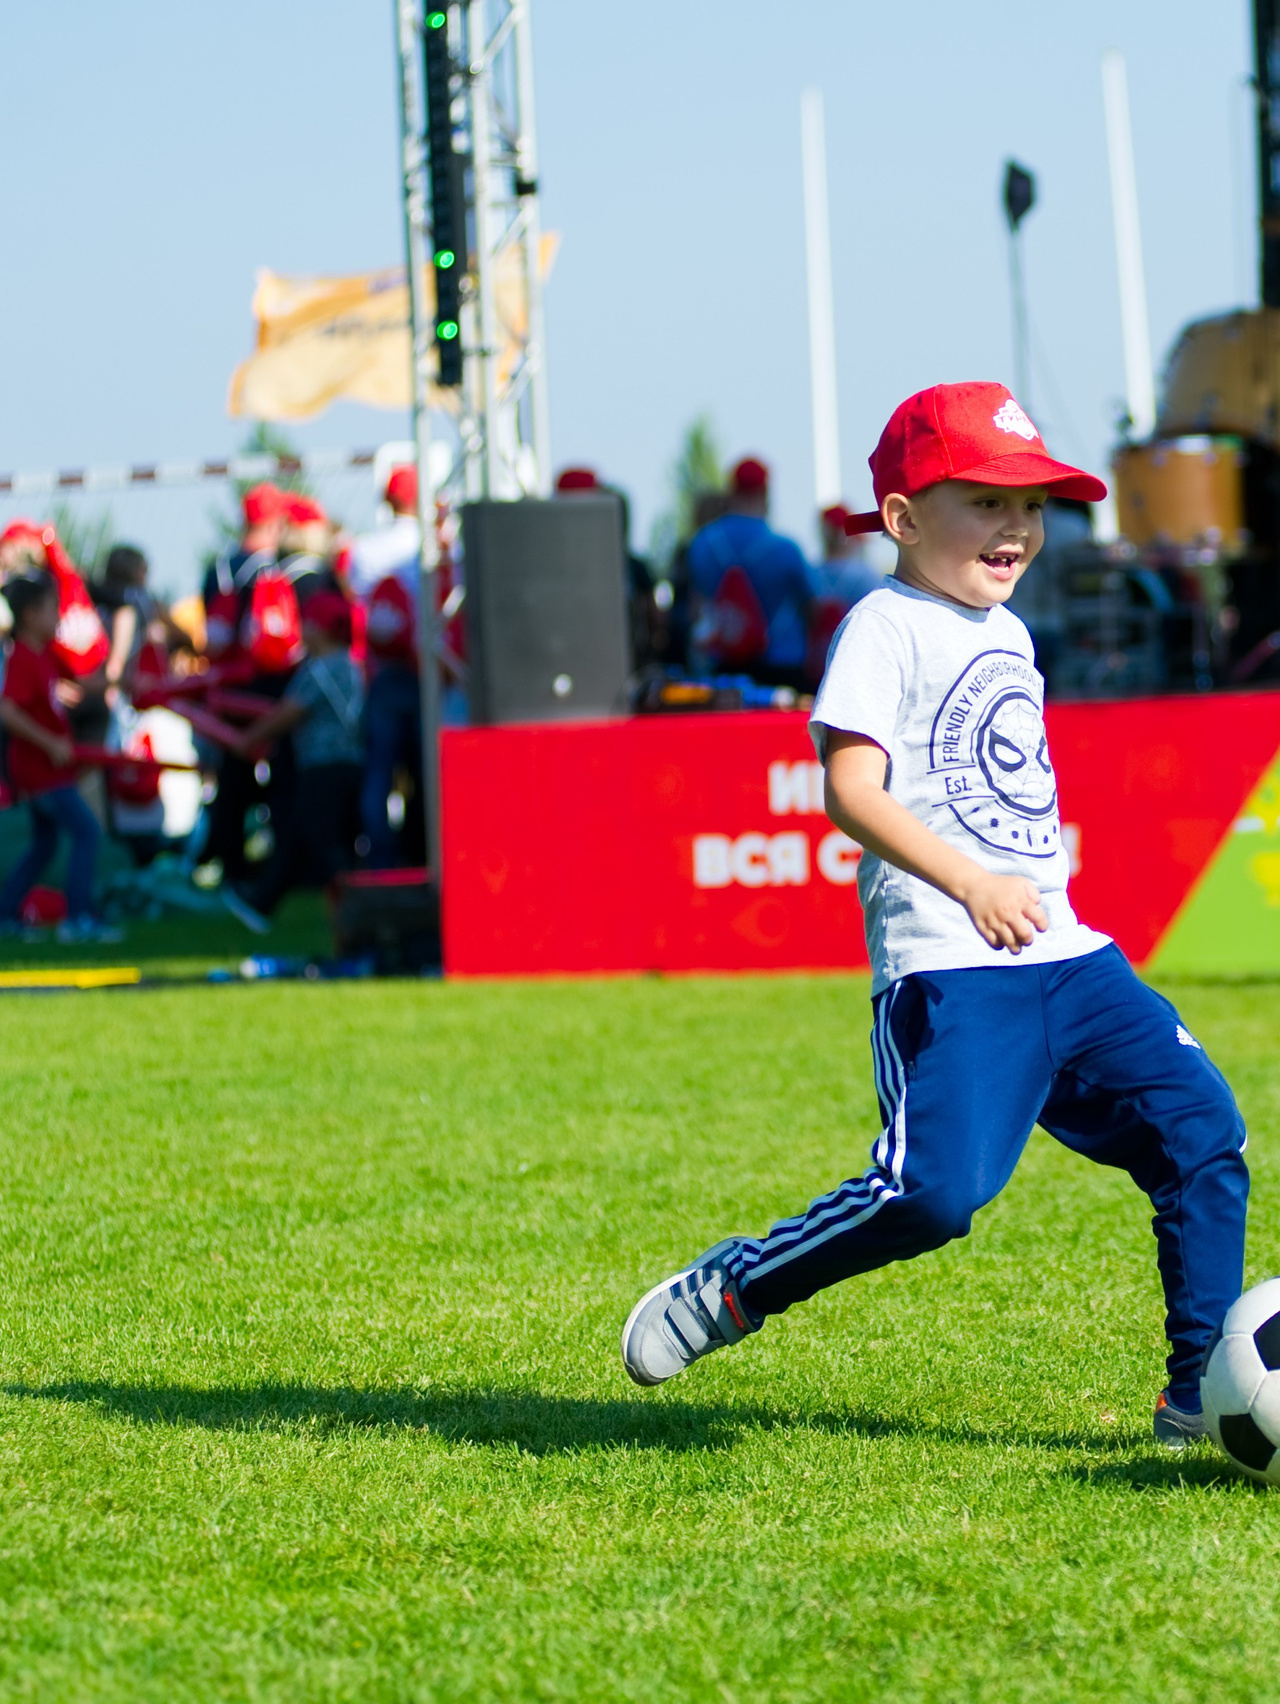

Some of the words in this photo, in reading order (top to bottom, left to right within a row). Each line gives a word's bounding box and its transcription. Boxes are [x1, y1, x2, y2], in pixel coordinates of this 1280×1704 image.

[943, 694, 973, 763] FRIENDLY
[967, 661, 1037, 698] NEIGHBORHOOD
[944, 775, 973, 795] Est.
[692, 829, 811, 889] ВСЯ
